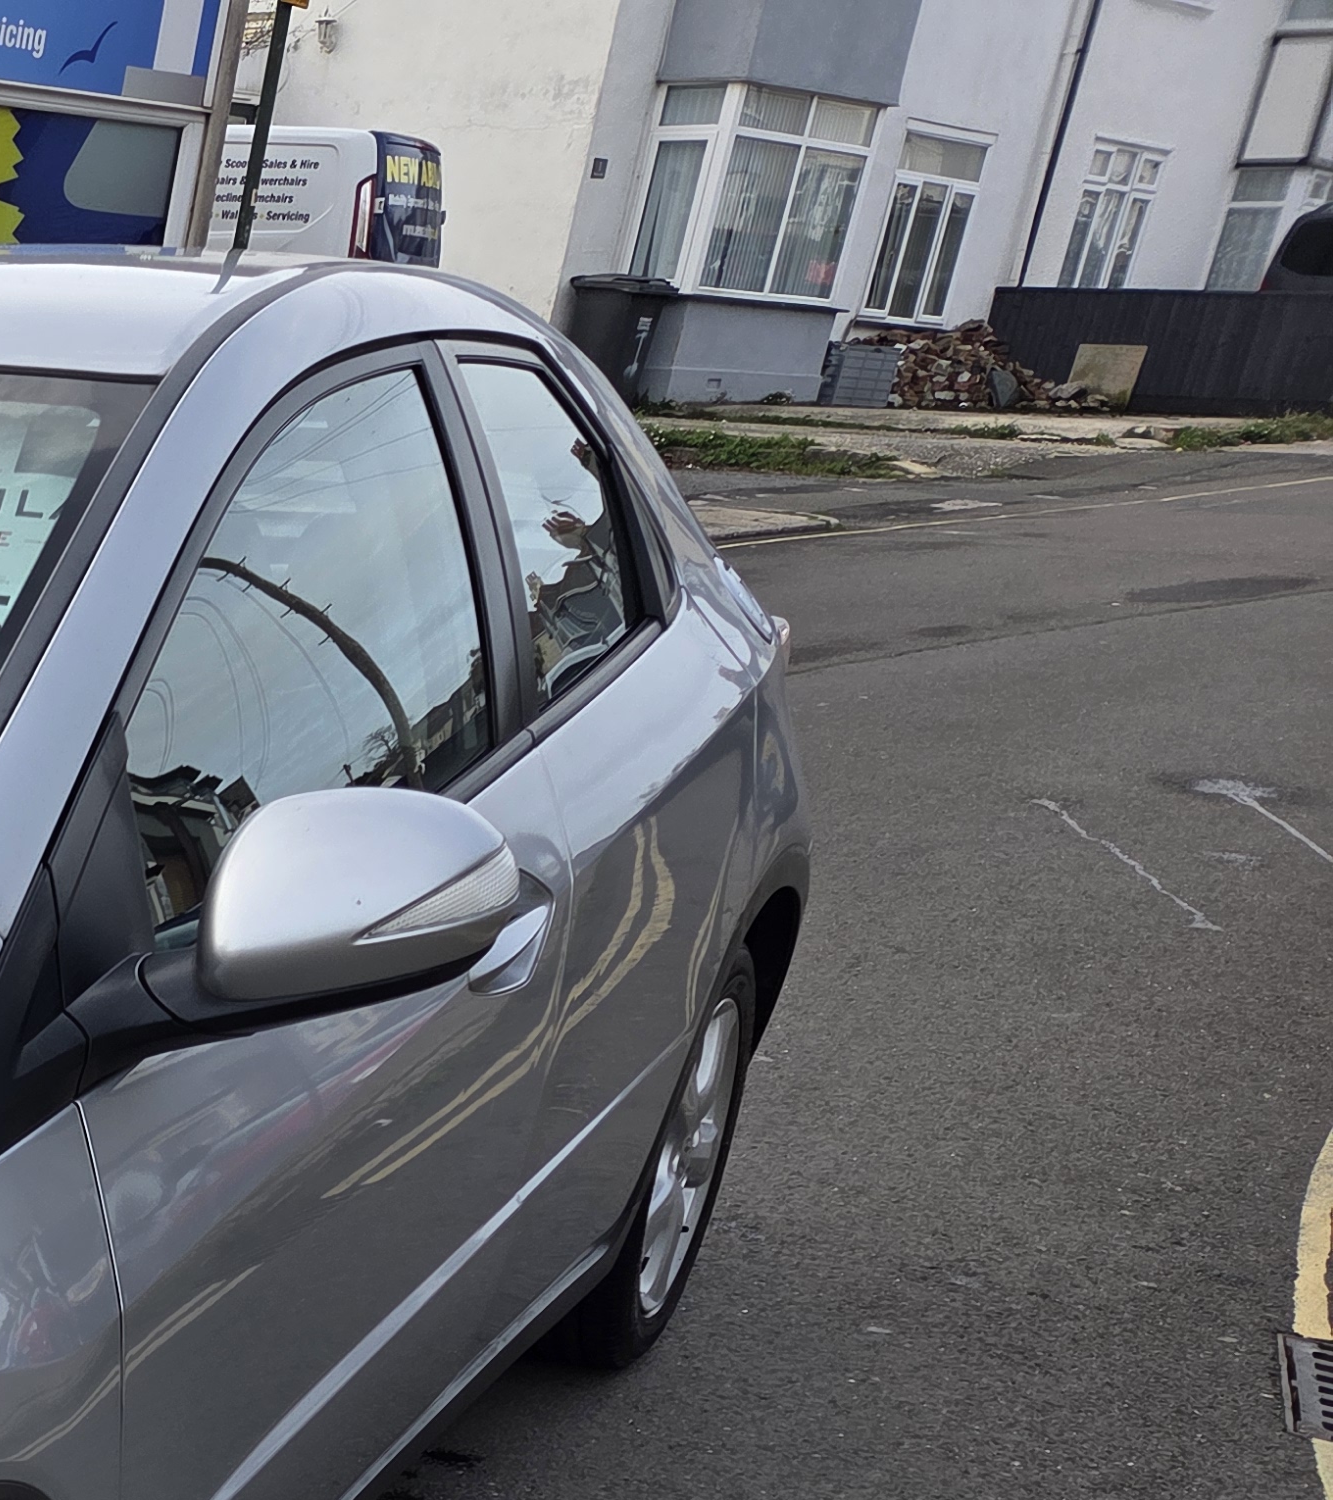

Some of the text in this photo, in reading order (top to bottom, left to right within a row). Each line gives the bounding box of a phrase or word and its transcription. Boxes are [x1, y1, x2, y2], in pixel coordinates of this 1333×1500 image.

[262, 159, 287, 170] Sales
[290, 160, 298, 169] &
[300, 160, 320, 170] Hire
[386, 155, 419, 185] NEW
[266, 210, 310, 224] Servicing
